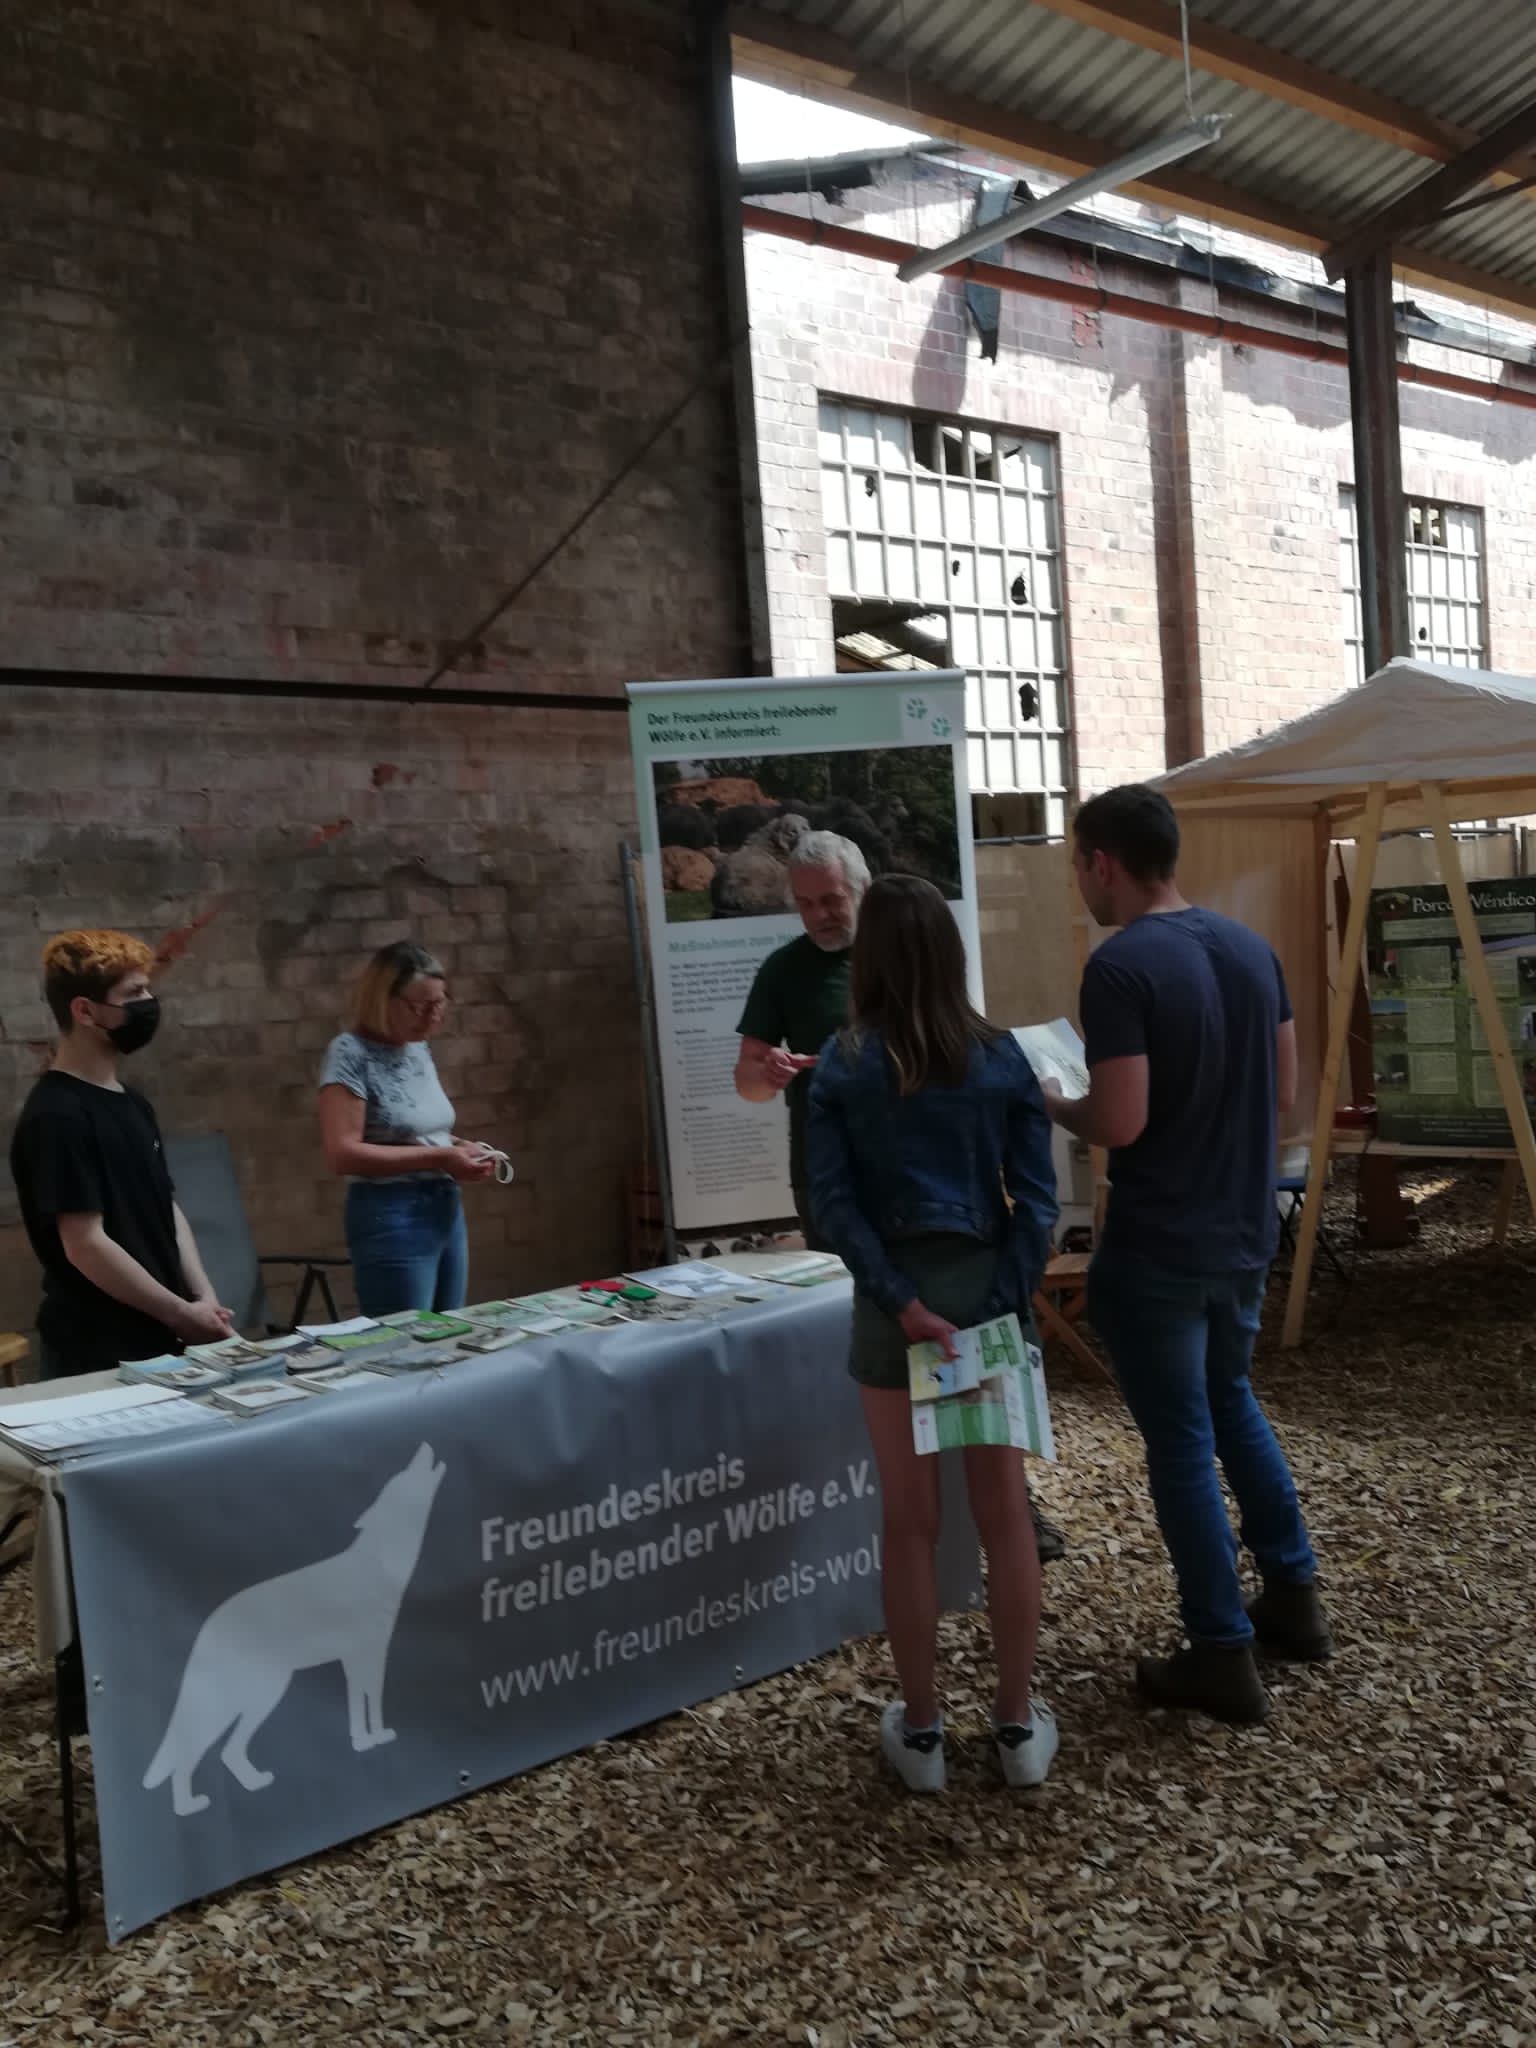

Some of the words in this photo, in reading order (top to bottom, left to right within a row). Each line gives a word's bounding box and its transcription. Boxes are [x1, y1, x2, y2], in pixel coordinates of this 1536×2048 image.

[648, 712, 669, 725] Der
[672, 707, 760, 723] Freundeskreis
[763, 704, 838, 718] freilebender
[648, 731, 686, 743] Wölfe
[714, 725, 783, 738] informiert:
[481, 1452, 745, 1561] Freundeskreis
[481, 1522, 719, 1622] freilebender
[724, 1482, 815, 1543] Wölfe
[822, 1460, 875, 1508] e.V.
